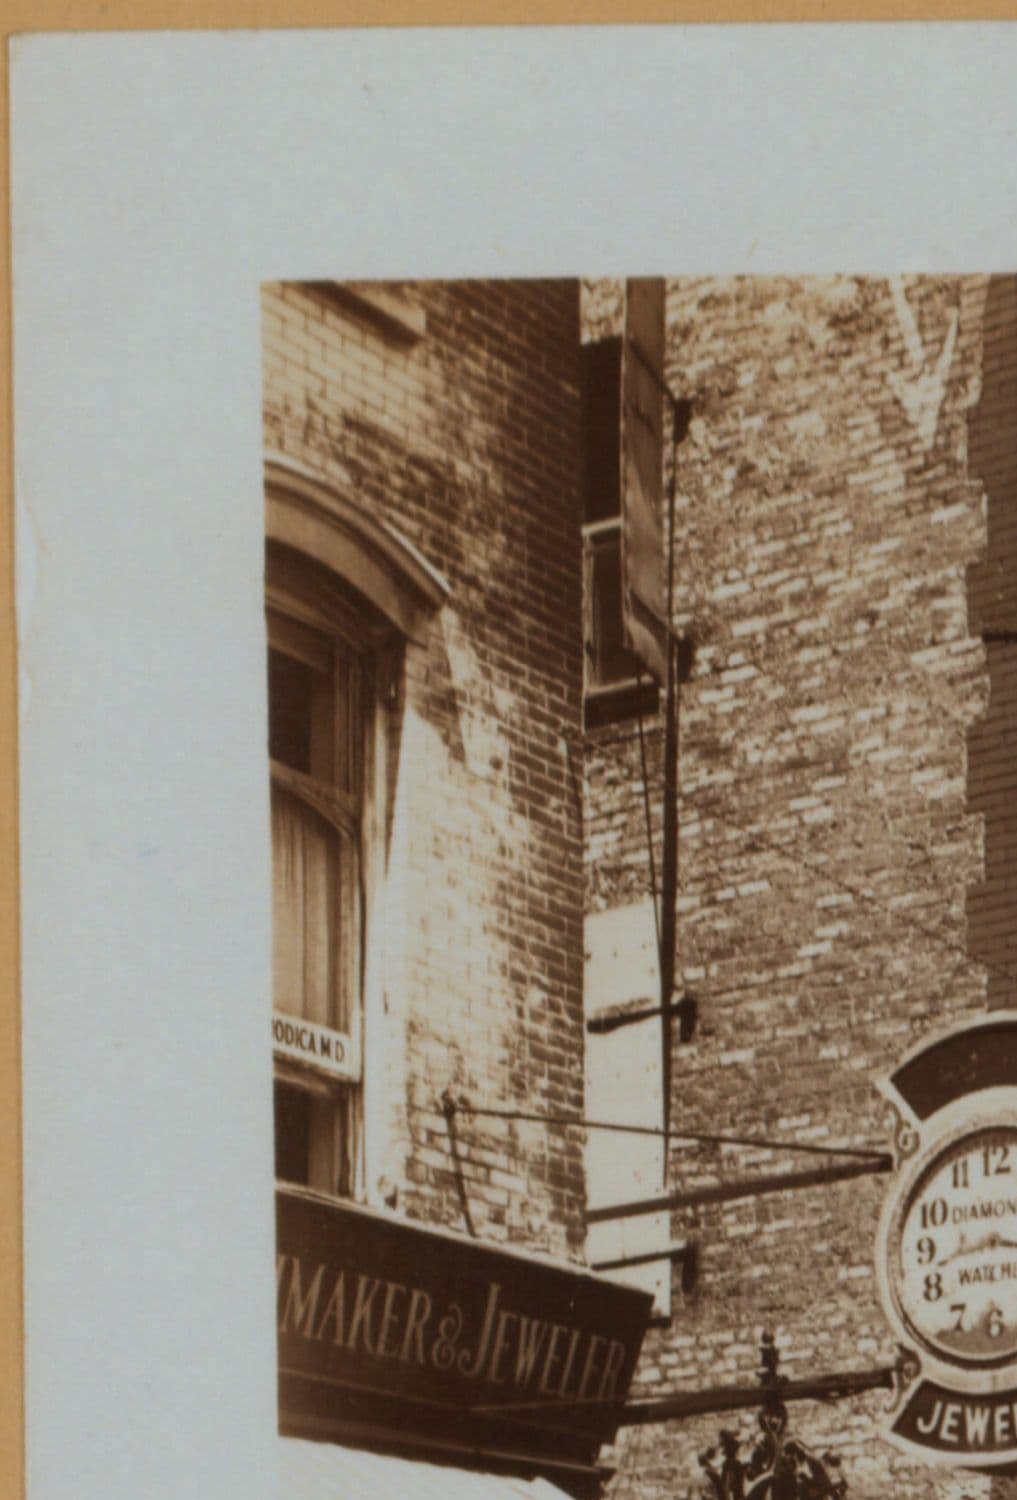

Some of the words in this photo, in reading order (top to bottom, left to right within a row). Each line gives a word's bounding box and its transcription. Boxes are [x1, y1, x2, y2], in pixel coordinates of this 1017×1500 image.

[272, 1018, 316, 1054] ODICA
[951, 1159, 971, 1189] 11
[983, 1146, 1011, 1178] 12
[920, 1199, 948, 1228] 10
[916, 1237, 937, 1265] 9
[923, 1272, 943, 1302] 8
[950, 1303, 967, 1332] 7
[987, 1310, 1004, 1339] 6
